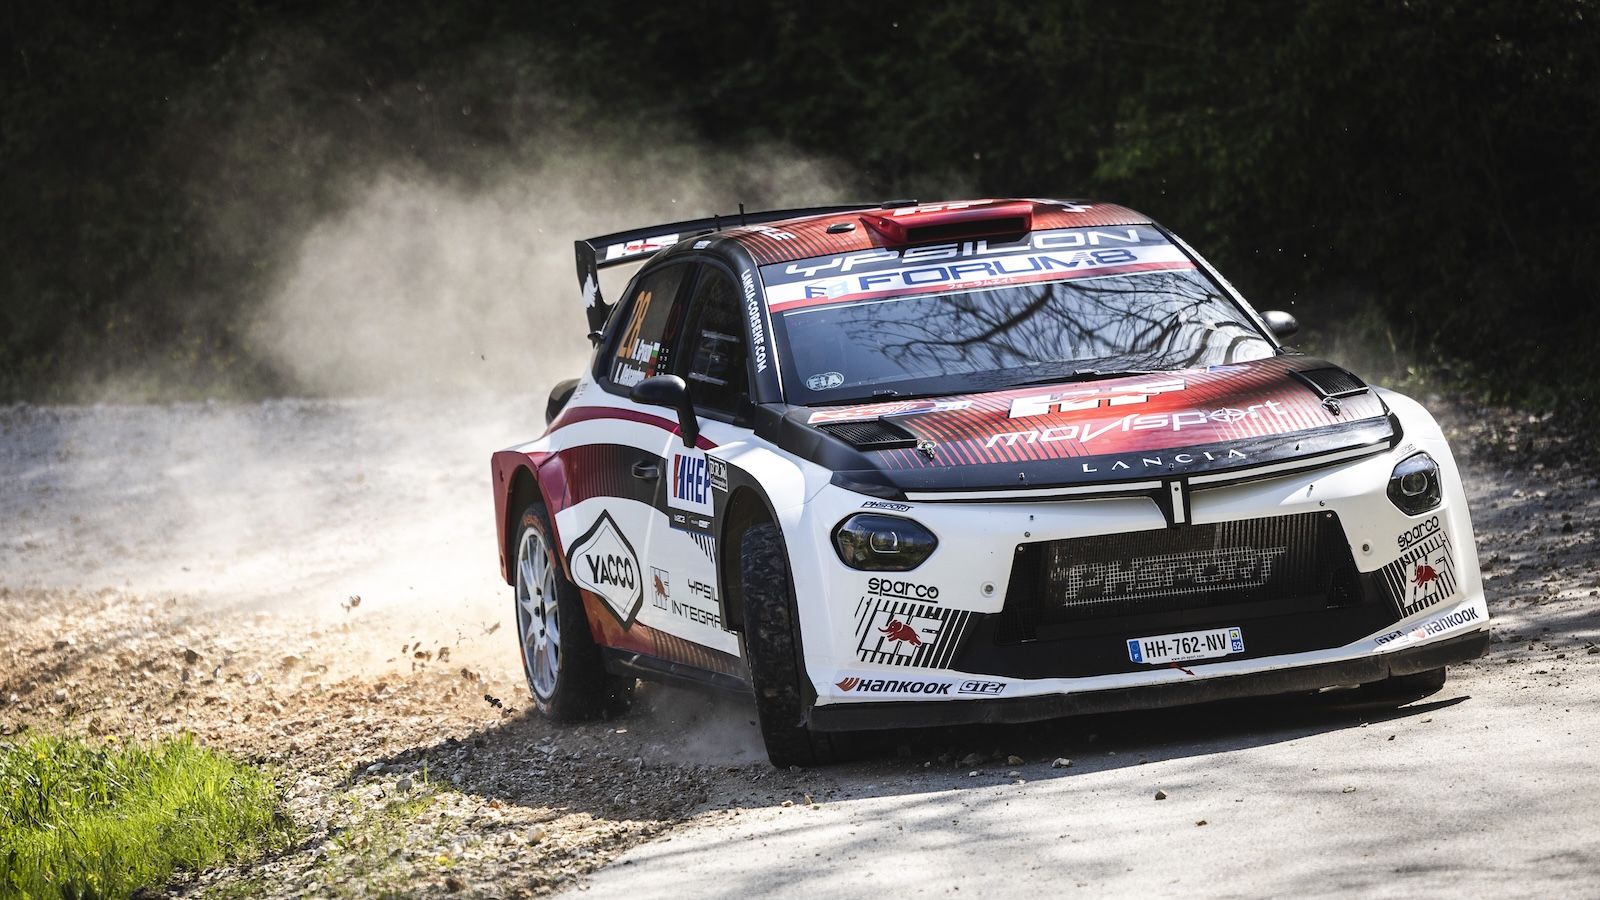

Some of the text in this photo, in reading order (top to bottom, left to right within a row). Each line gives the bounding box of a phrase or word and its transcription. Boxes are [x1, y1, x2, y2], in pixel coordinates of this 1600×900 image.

[785, 229, 1141, 277] YPSILON
[858, 249, 1139, 290] FORUM8
[617, 290, 652, 359] 28
[809, 374, 842, 389] FIA
[1083, 449, 1246, 474] LANCIA
[1397, 516, 1439, 548] sparco
[585, 554, 635, 591] YACCO
[1065, 546, 1286, 601] PHSPORT
[687, 579, 719, 602] YPSIL
[868, 577, 939, 599] sparco
[1144, 633, 1226, 658] HH-762-NV
[1232, 641, 1243, 650] 52
